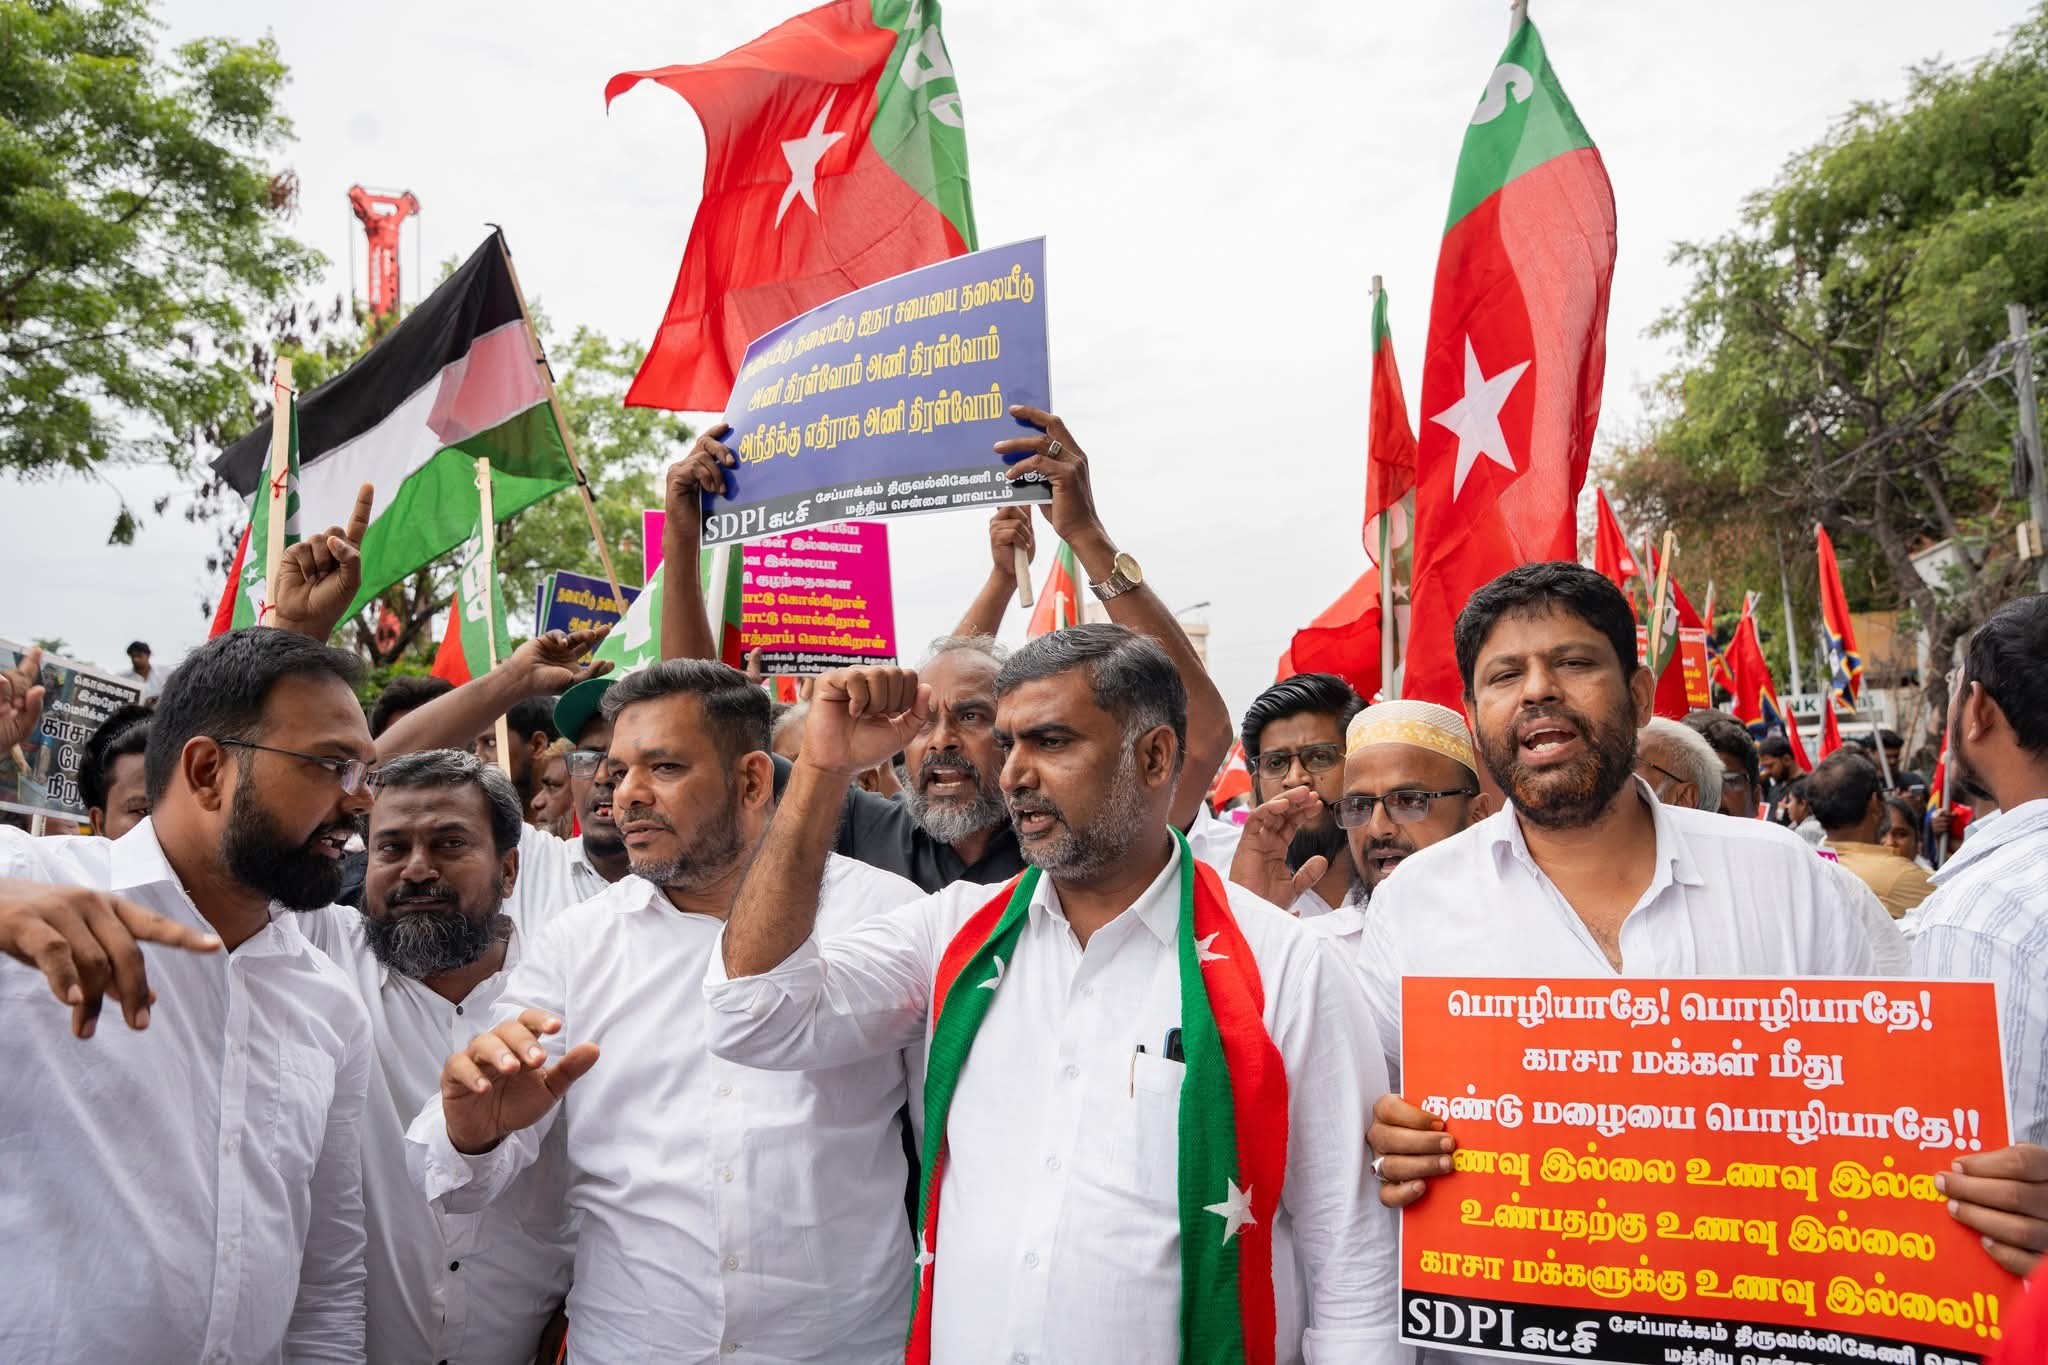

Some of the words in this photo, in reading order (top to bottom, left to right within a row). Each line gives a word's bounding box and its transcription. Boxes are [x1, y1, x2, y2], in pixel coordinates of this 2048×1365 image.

[857, 303, 893, 337] ஐநா
[894, 287, 958, 325] சபையை
[747, 376, 785, 412] அணி
[782, 354, 863, 406] திரள்வோம்
[866, 345, 907, 383] அணி
[908, 325, 1001, 380] திரள்வோம்
[738, 421, 801, 466] அநீதிக்கு
[803, 413, 861, 451] எதிராக
[863, 399, 906, 439] அணி
[907, 382, 1004, 436] திரள்வோம்
[816, 482, 885, 504] சேப்பாக்கம்
[887, 470, 991, 497] திருவல்லிகேணி
[845, 502, 888, 517] மத்திய
[891, 494, 949, 511] சென்னை
[952, 486, 1014, 505] மாவட்டம்
[705, 506, 767, 541] SDPI
[768, 499, 812, 529] கட்சி
[1448, 985, 1670, 1028] பொழியாதே!
[1681, 987, 1932, 1033] பொழியாதே!
[1522, 1047, 1622, 1073] காசா
[1632, 1037, 1759, 1076] மக்கள்
[1769, 1038, 1844, 1090] மீது
[1532, 1101, 1696, 1137] மழையை
[1705, 1099, 1982, 1151] பொழியாதே!!
[1452, 1148, 1531, 1186] ணவு
[1540, 1141, 1676, 1184] இல்லை
[1685, 1158, 1818, 1202] உணவு
[1460, 1191, 1648, 1244] உண்பதற்கு
[1656, 1211, 1779, 1256] உணவு
[1788, 1210, 1936, 1262] இல்லை
[1420, 1249, 1504, 1281] காசா
[1512, 1248, 1687, 1302] மக்களுக்கு
[1695, 1269, 1817, 1317] உணவு
[1825, 1271, 2003, 1340] இல்லை!!
[1407, 1298, 1515, 1348] SDPI
[1520, 1320, 1600, 1354] கட்சி
[1608, 1316, 1729, 1342] சேப்பாக்கம்
[1734, 1325, 1917, 1365] திருவல்லிகேணி
